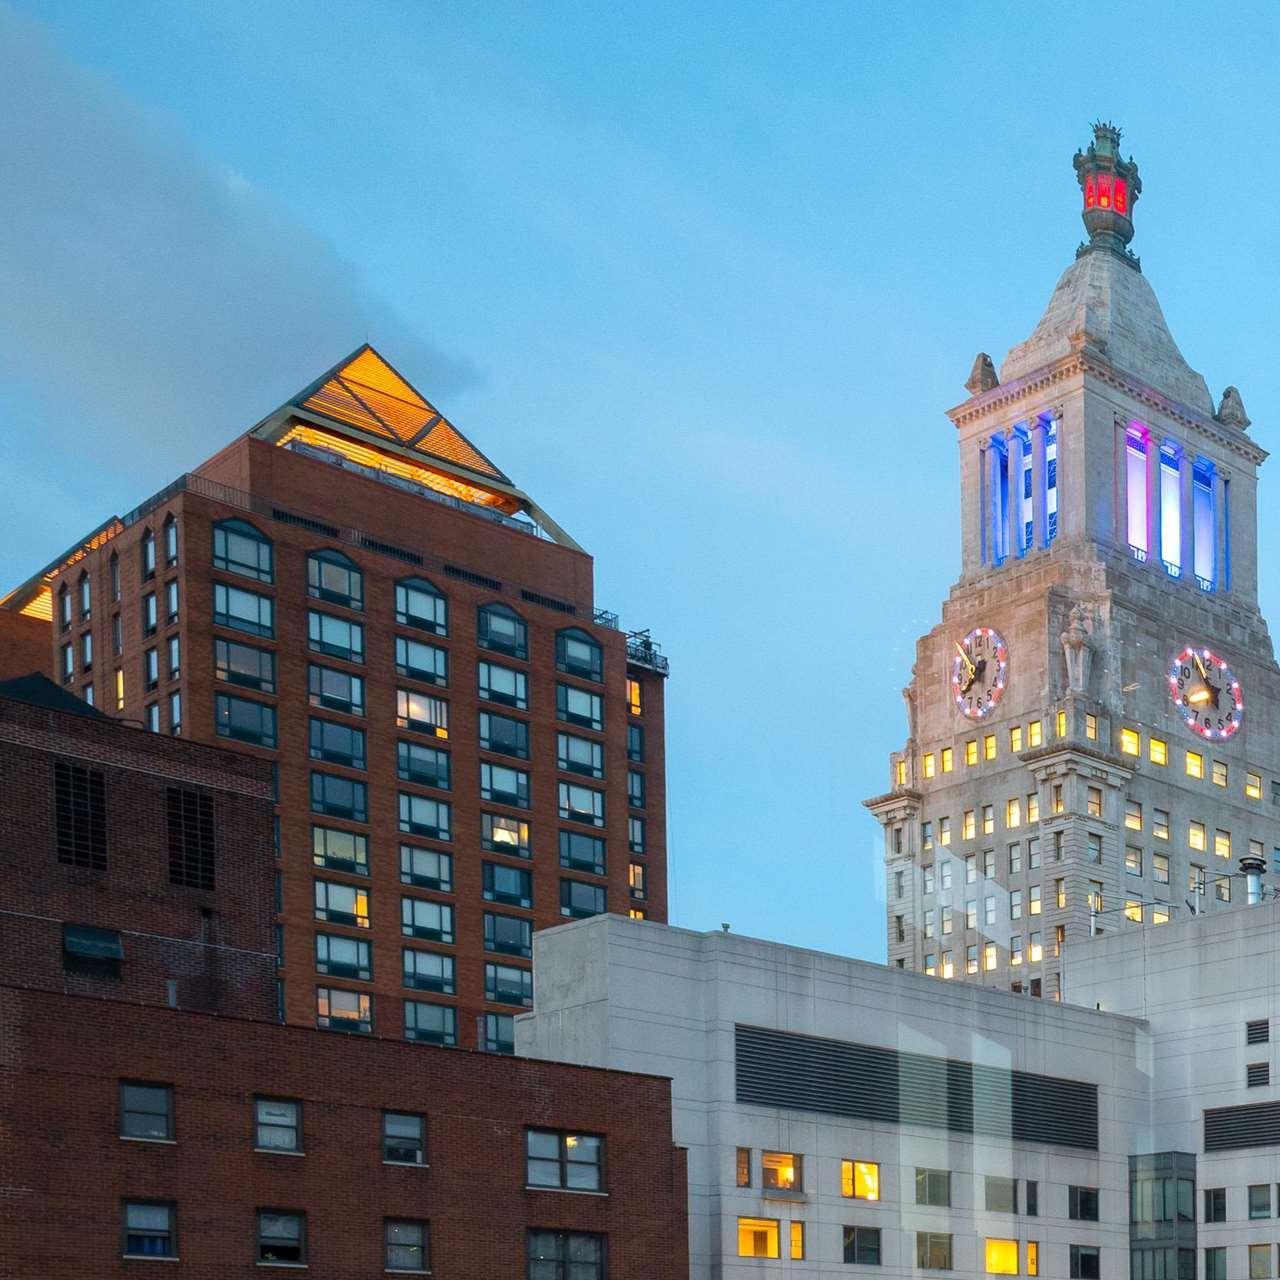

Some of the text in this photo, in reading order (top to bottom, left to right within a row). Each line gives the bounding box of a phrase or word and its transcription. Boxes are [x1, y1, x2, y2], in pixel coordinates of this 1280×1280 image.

[975, 636, 982, 647] 12
[1180, 665, 1190, 679] 10
[1178, 678, 1184, 689] 9
[1226, 683, 1232, 695] 2
[986, 690, 992, 702] 5
[968, 696, 973, 709] 7
[977, 697, 982, 708] 6
[1192, 710, 1199, 721] 7
[1226, 712, 1232, 721] 4
[1204, 718, 1211, 729] 6
[1218, 719, 1224, 730] 5
